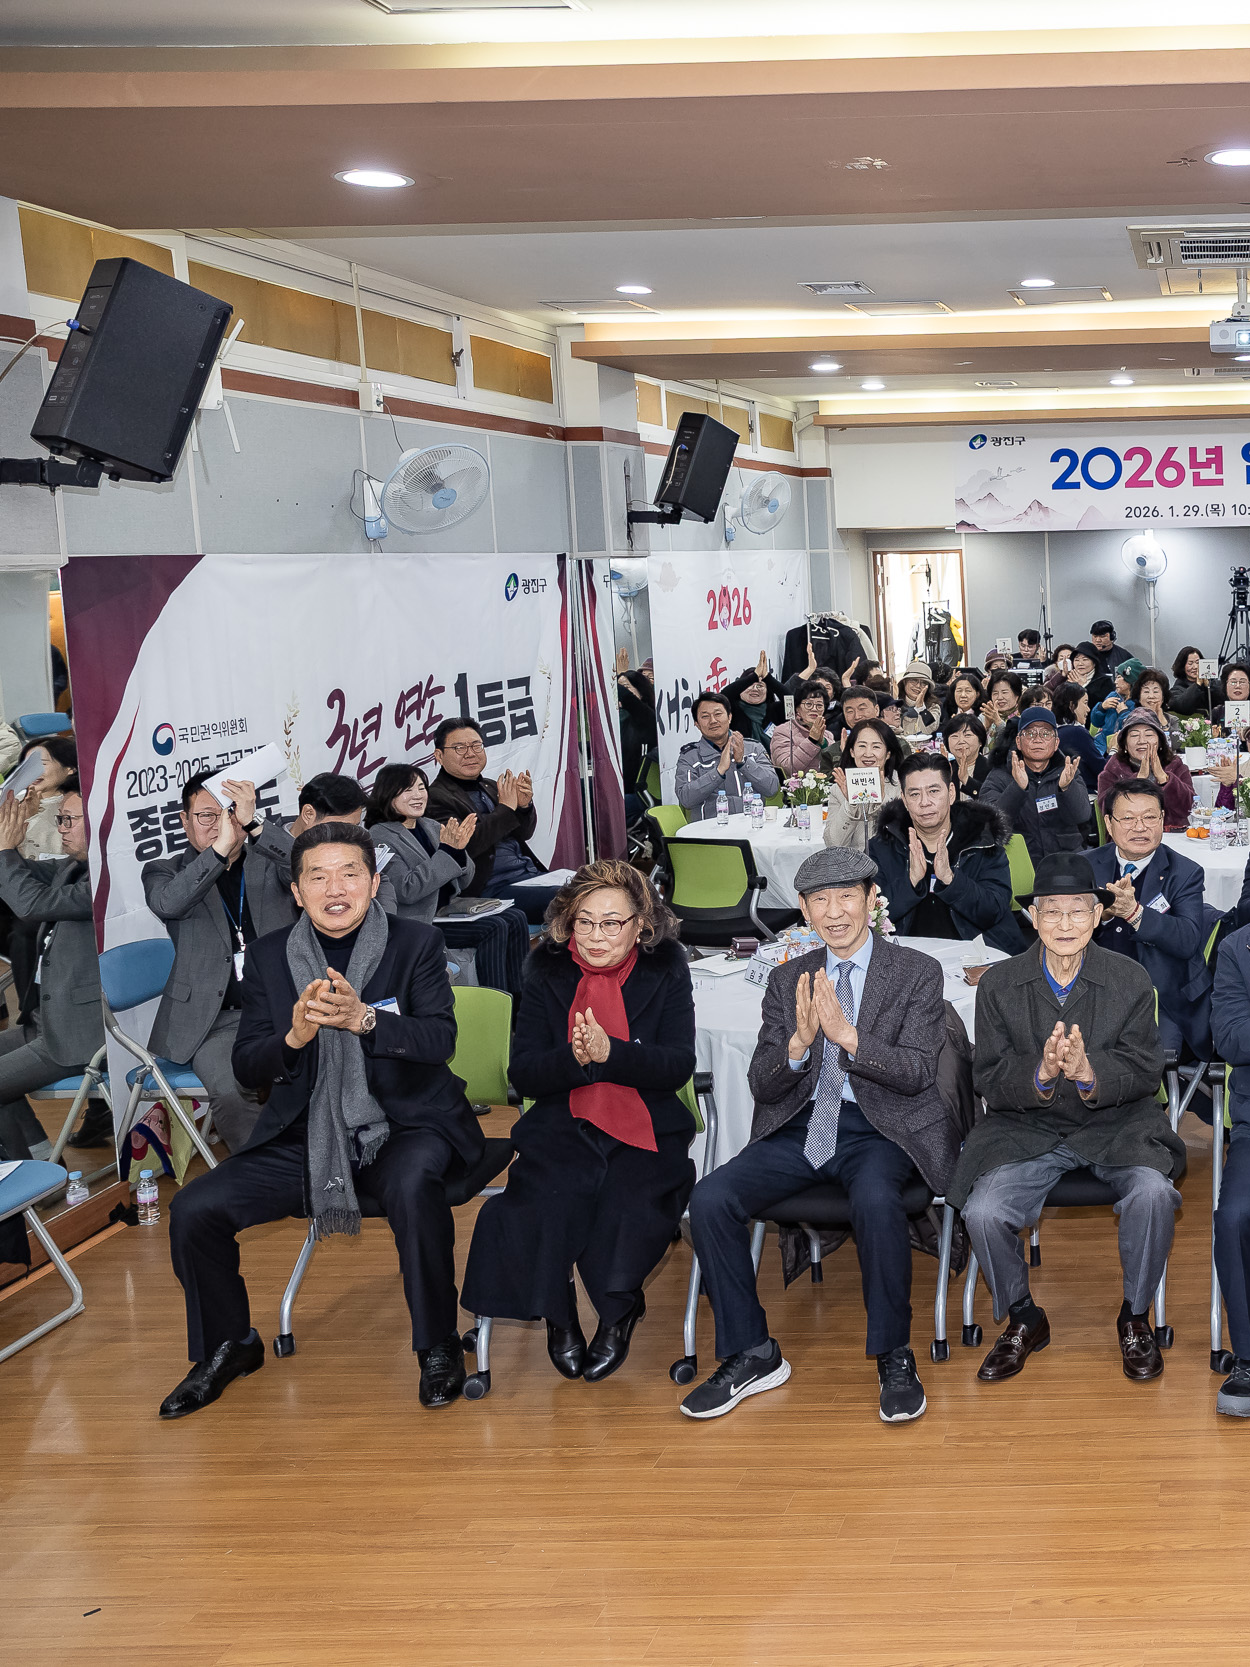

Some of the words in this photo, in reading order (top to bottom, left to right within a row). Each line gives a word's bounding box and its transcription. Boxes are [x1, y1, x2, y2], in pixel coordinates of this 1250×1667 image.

[990, 436, 1026, 447] 광진구
[1049, 445, 1224, 491] 2026년
[1125, 505, 1164, 519] 2026.
[521, 578, 548, 595] 광진구
[453, 671, 539, 749] 1등급
[1234, 707, 1241, 716] 2
[178, 717, 248, 744] 국민권익위원회
